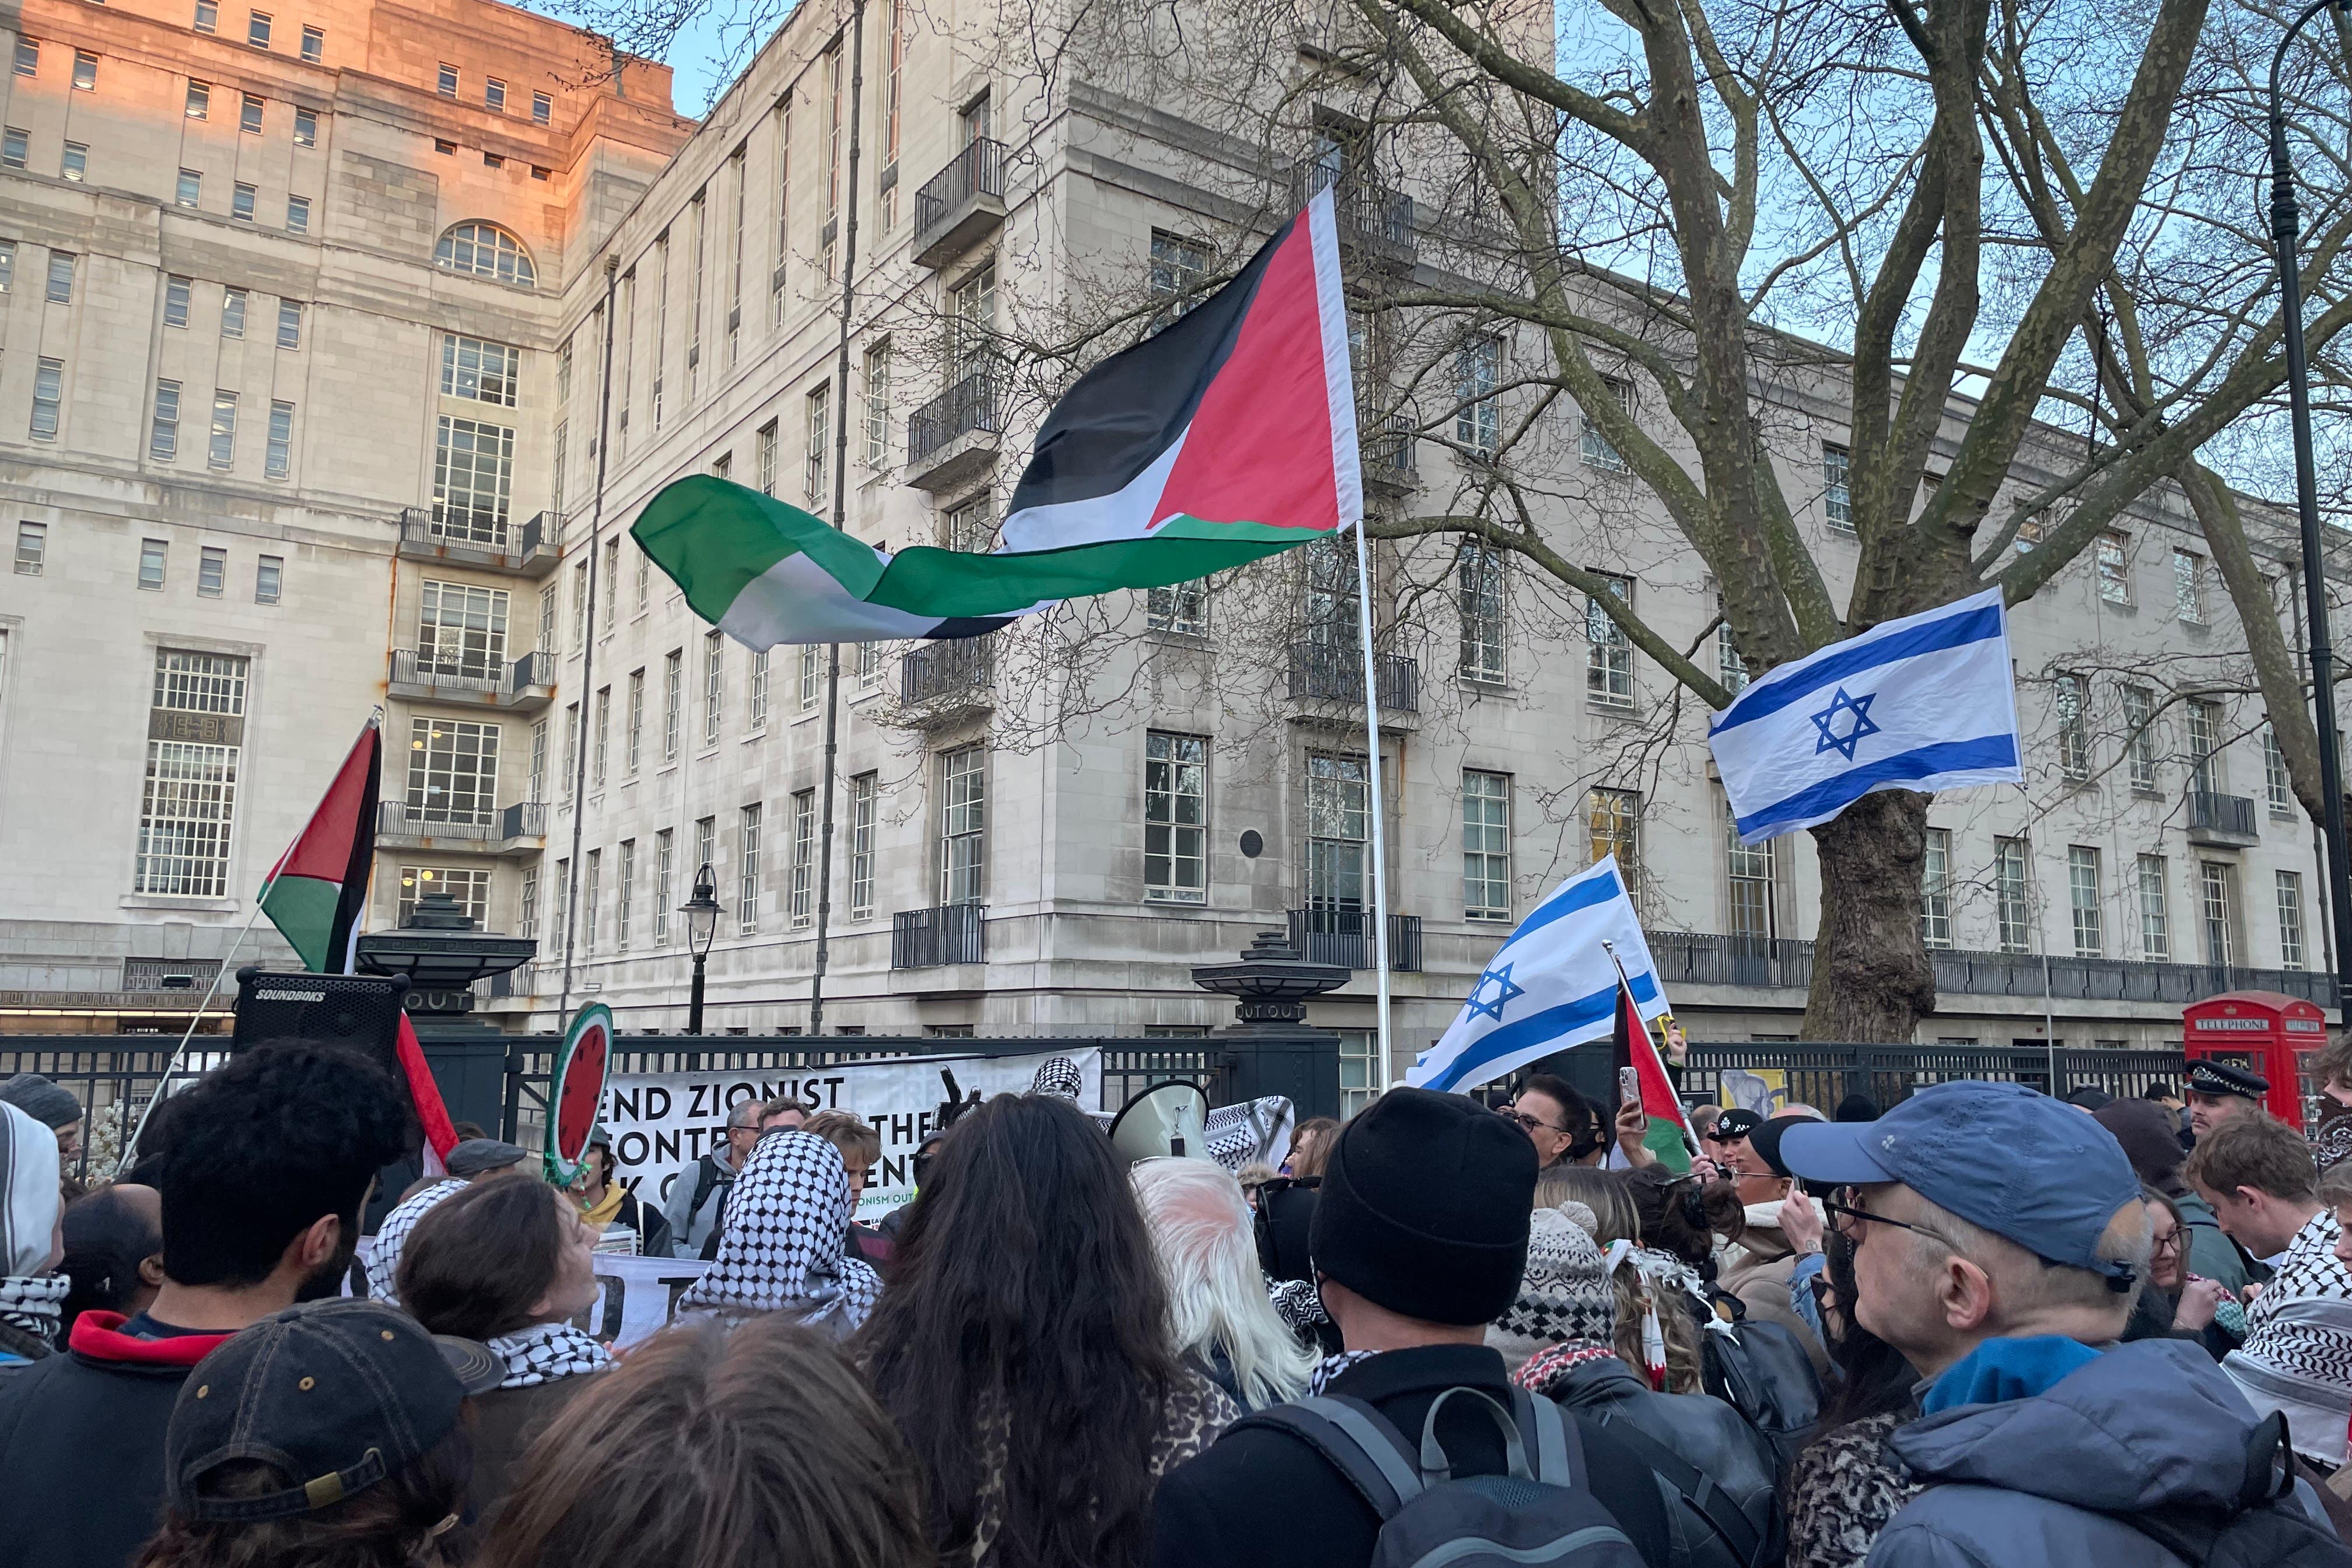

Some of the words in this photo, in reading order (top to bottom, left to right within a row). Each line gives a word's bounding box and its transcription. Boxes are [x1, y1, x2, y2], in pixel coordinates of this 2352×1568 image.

[256, 989, 326, 1002] SOUNDBOKS
[404, 993, 470, 1010] OUT
[1236, 1005, 1262, 1019] OUT
[1268, 1005, 1305, 1019] OUT
[2200, 1020, 2267, 1030] TELEPHONE
[869, 1111, 932, 1145] THE
[892, 1193, 915, 1203] OUT
